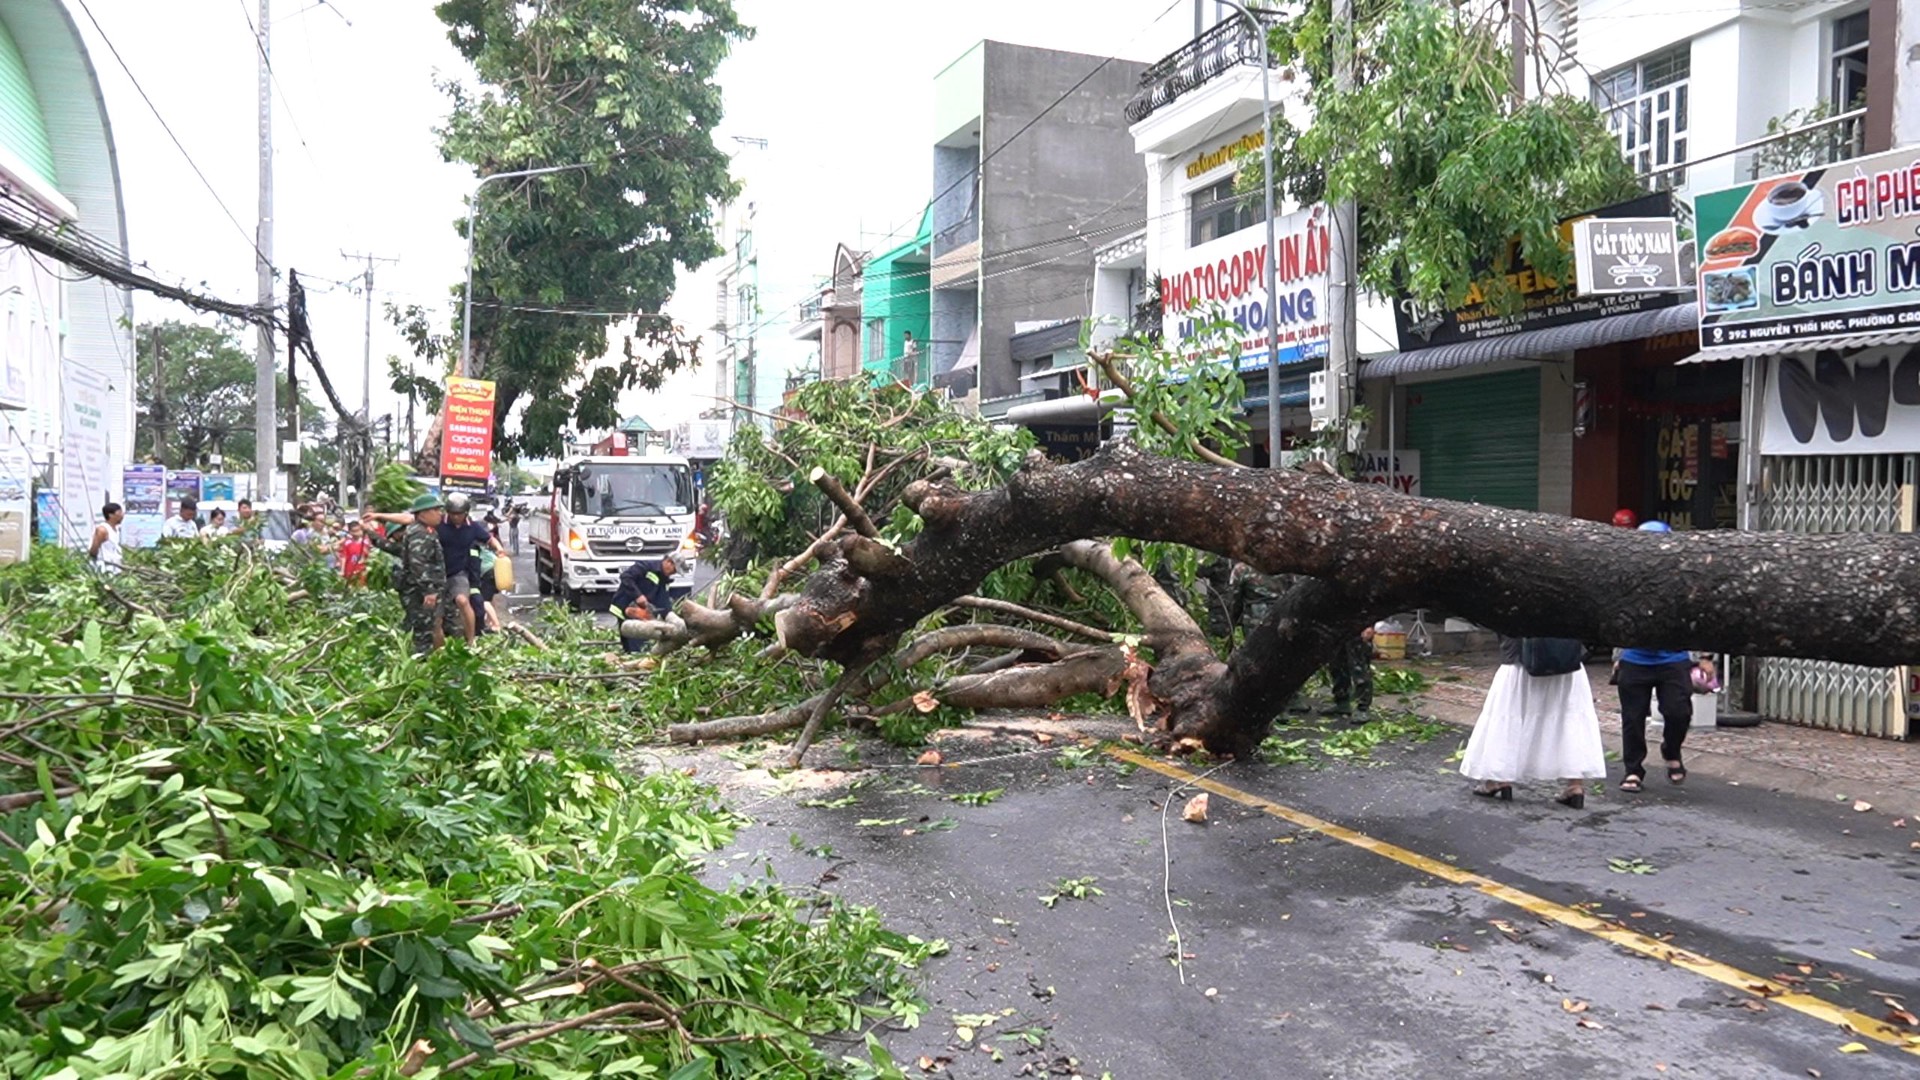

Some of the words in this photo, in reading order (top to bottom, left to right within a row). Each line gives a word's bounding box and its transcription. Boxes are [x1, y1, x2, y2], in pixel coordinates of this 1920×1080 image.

[1836, 167, 1869, 226] CÀ
[1594, 223, 1617, 255] CẮT
[1619, 227, 1643, 254] TÓC
[1644, 232, 1671, 254] NAM
[1161, 245, 1268, 315] PHOTOCOPY
[1280, 234, 1301, 283] IN
[1772, 243, 1876, 306] BÁNH
[1234, 288, 1316, 333] HONG
[1618, 294, 1636, 303] Cao
[1728, 330, 1747, 340] 392
[1750, 325, 1790, 338] NGUYỄN
[1793, 321, 1818, 334] THÁI
[449, 424, 488, 434] SAMSUNG
[1658, 461, 1692, 500] TÓC
[587, 527, 596, 535] XE
[643, 526, 659, 535] CÂY
[662, 527, 682, 535] XANH
